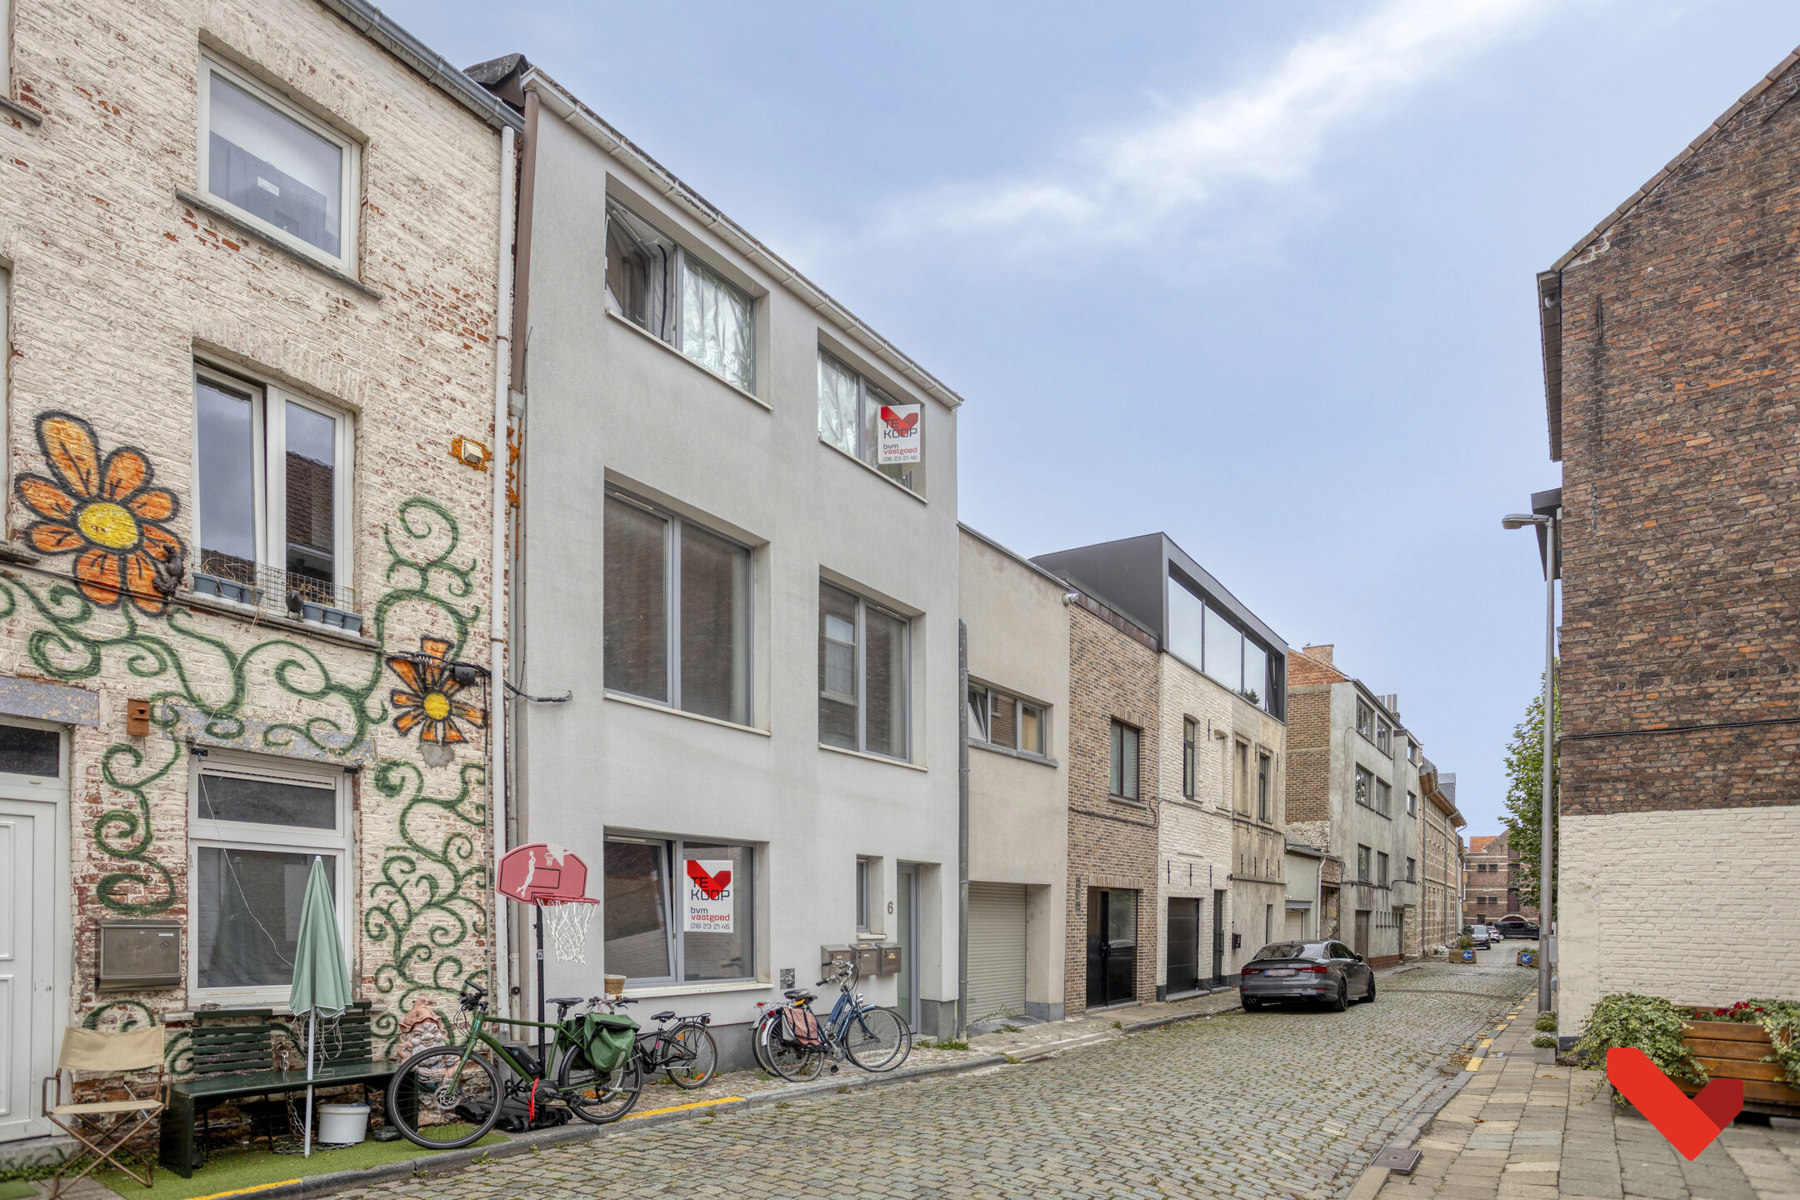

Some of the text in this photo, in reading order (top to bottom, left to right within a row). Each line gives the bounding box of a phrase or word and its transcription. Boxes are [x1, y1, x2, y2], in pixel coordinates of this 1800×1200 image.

[884, 419, 898, 428] TE
[884, 428, 918, 438] KOOP
[691, 877, 708, 888] TE
[691, 890, 730, 900] KOOP
[888, 901, 894, 914] 6
[691, 914, 730, 922] vastgoed
[884, 951, 887, 959] 3
